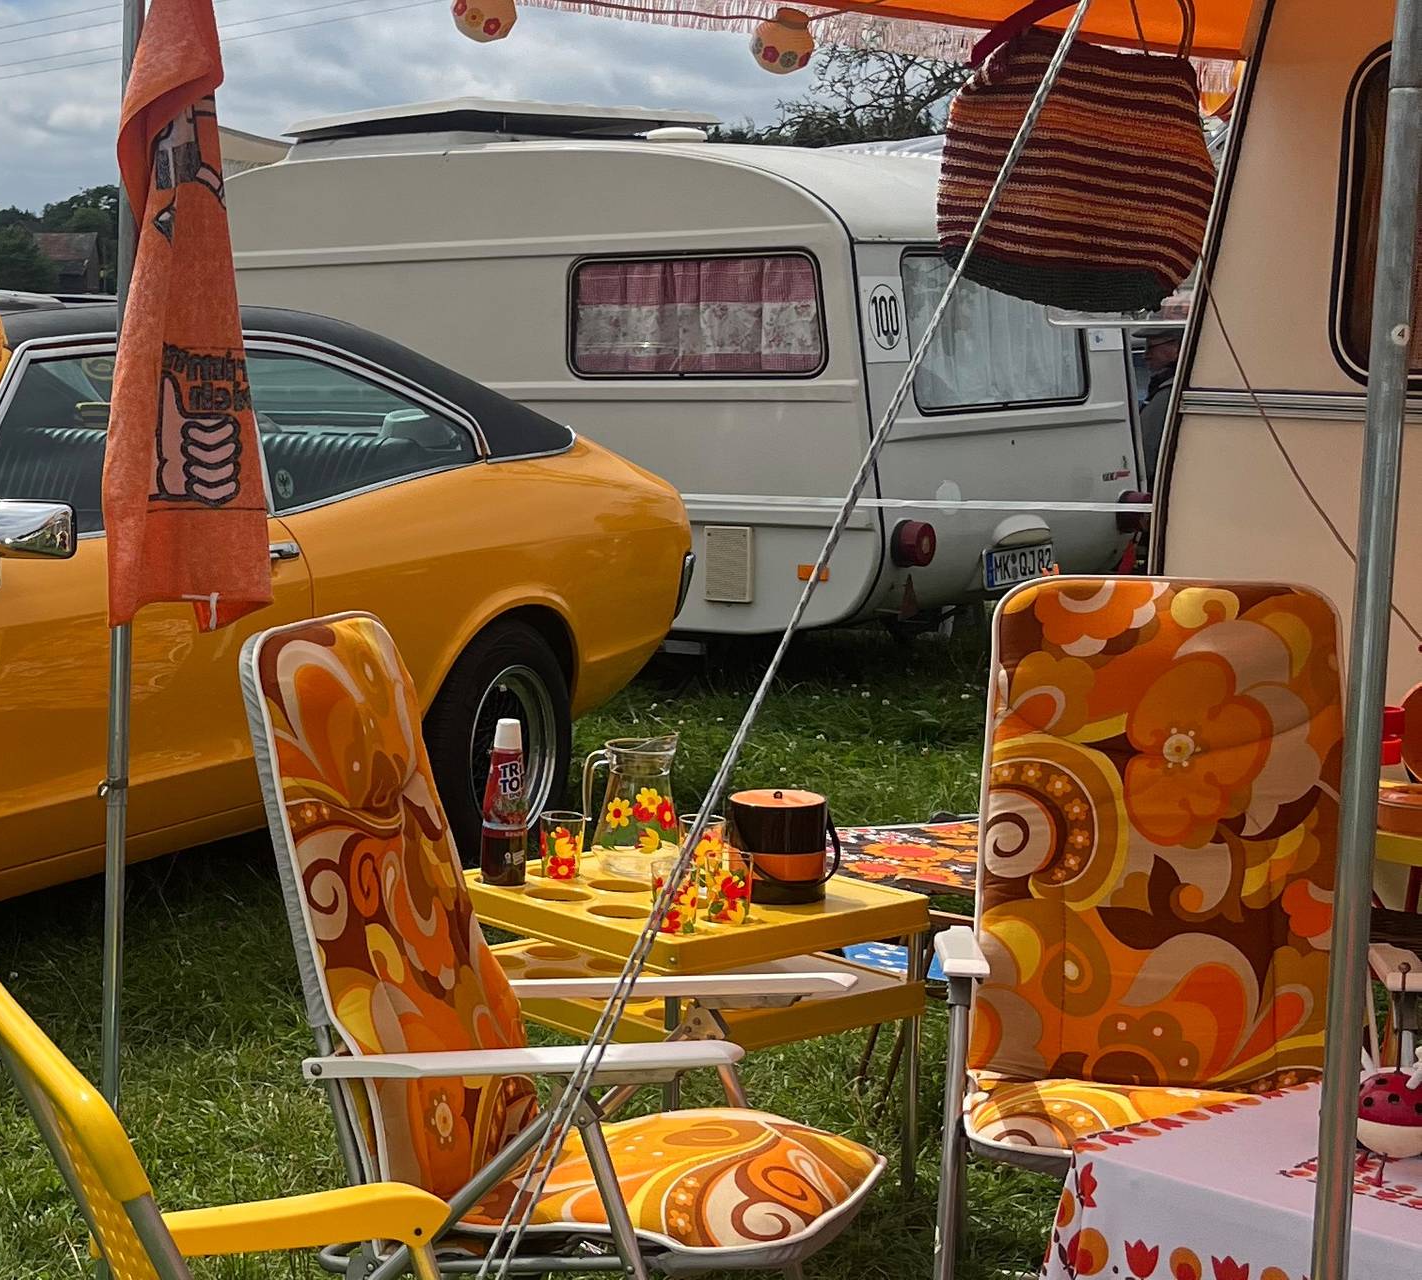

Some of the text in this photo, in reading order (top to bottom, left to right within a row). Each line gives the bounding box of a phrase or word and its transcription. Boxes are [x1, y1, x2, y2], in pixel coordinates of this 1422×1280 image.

[871, 295, 900, 338] 100
[1397, 327, 1406, 340] 4
[994, 554, 1012, 582] MK
[1019, 550, 1036, 577] QJ
